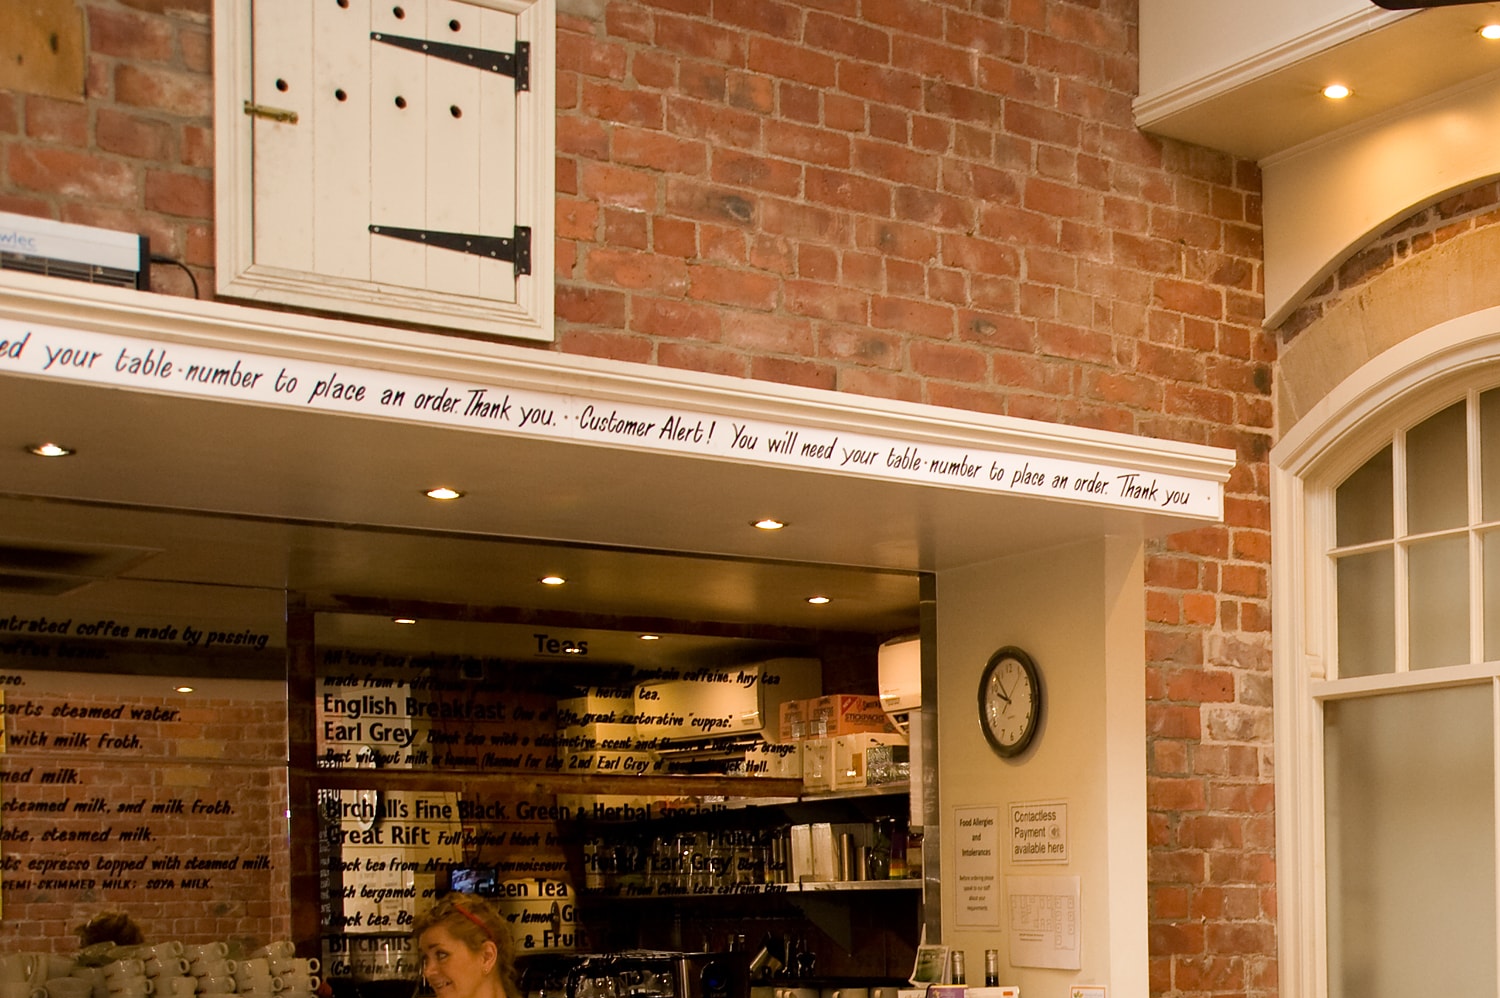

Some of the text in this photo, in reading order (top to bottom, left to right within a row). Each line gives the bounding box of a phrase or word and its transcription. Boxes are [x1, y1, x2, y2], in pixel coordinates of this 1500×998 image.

[43, 345, 102, 370] your
[115, 348, 173, 378] table
[185, 360, 263, 389] number
[274, 368, 298, 393] to
[308, 373, 366, 404] place
[380, 388, 405, 406] an
[464, 388, 511, 421] Thank
[579, 405, 655, 437] Customer
[730, 423, 758, 450] You
[768, 431, 799, 455] will
[801, 437, 838, 460] need
[841, 447, 879, 466] your
[886, 446, 921, 471] table
[929, 454, 983, 478] number
[989, 460, 1005, 481] to
[1010, 462, 1046, 488] place
[1051, 473, 1069, 489] an
[1117, 473, 1159, 502] Thank
[1161, 488, 1191, 507] you
[76, 619, 270, 650] coffee made by passing
[533, 633, 589, 656] Teas
[736, 670, 758, 688] Any
[761, 672, 781, 685] tea
[51, 702, 125, 720] steamed
[323, 693, 685, 727] English Breakfast great restorative
[9, 729, 49, 747] with
[53, 732, 90, 748] milk
[324, 721, 418, 748] Earl Grey
[568, 755, 650, 773] 2nd Earl Grey
[1, 798, 186, 814] steamed and milk
[415, 799, 452, 819] Fine
[515, 800, 570, 821] Green
[592, 802, 651, 822] Herbal
[959, 817, 994, 828] Food Allergies
[1013, 809, 1057, 823] Contactless
[41, 826, 113, 843] steamed
[328, 825, 430, 845] Great Rift
[971, 833, 982, 842] and
[1014, 826, 1046, 841] Payment
[1014, 841, 1065, 855] available here
[27, 856, 237, 878] espresso topped with steamed
[366, 858, 418, 873] tea from
[145, 878, 175, 890] SOYA
[360, 877, 568, 904] bergamot Tea
[543, 930, 586, 949] Fruit
